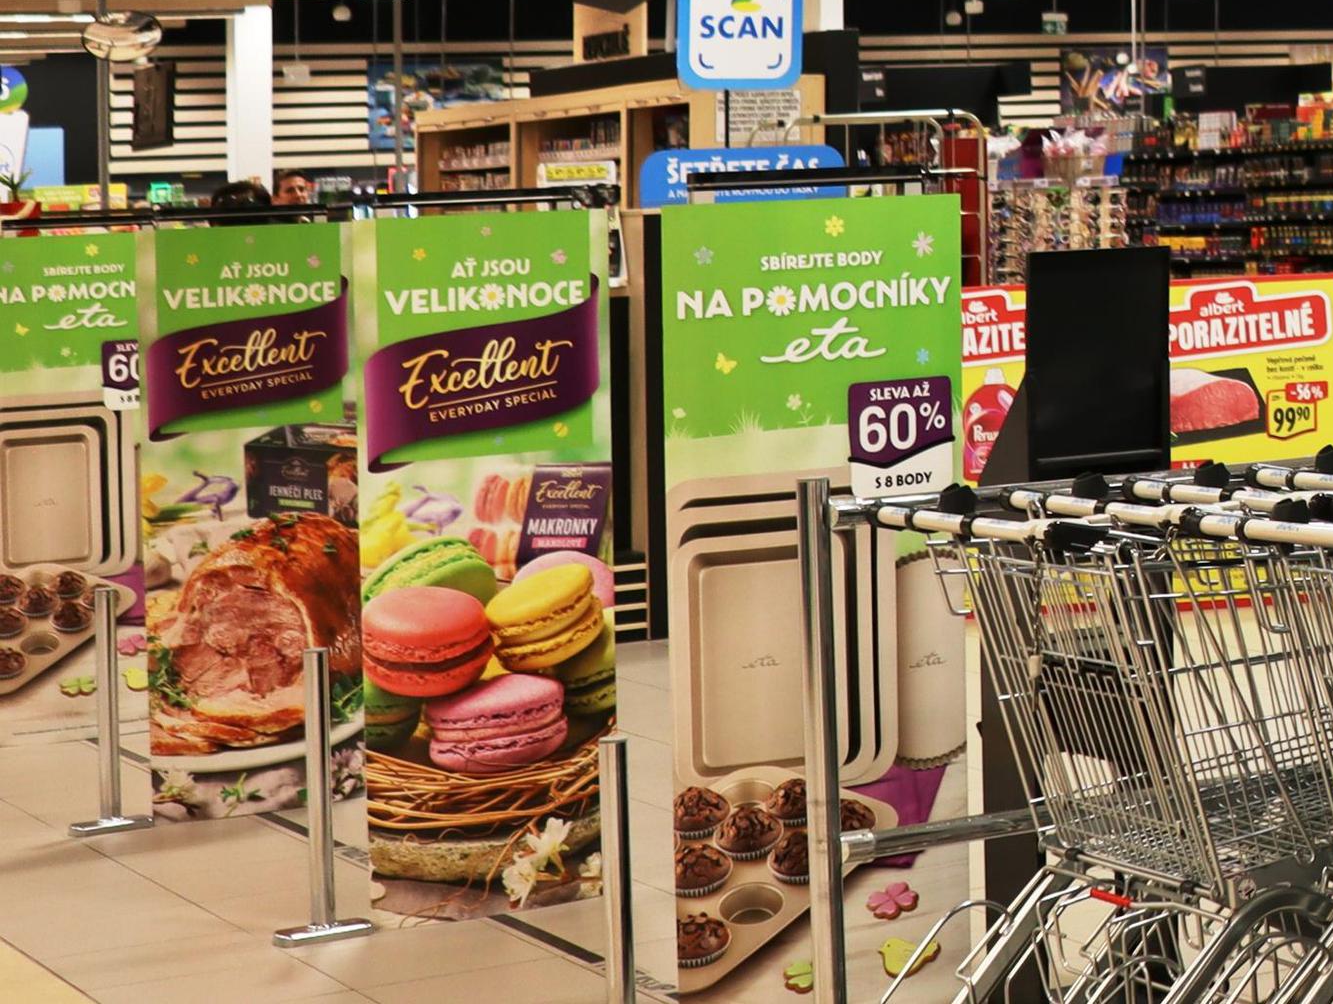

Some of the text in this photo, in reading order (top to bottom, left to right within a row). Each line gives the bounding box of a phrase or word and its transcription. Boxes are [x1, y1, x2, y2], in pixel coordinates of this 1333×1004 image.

[700, 14, 783, 39] SCAN
[94, 263, 125, 276] BODY
[220, 261, 289, 280] AŤ JSOU
[451, 257, 531, 279] AŤ JSOU
[760, 250, 883, 272] SBÍREJTE BODY
[32, 281, 135, 303] POMOCN
[163, 279, 336, 310] VELIKONOCE
[385, 279, 585, 315] VELIKONOCE
[676, 289, 734, 320] NA
[1199, 301, 1245, 318] albert
[43, 303, 127, 331] eta
[962, 309, 998, 324] lbert
[1169, 302, 1315, 352] PORAZITELNÉ
[760, 317, 887, 363] eta
[176, 328, 326, 389] Excellent
[400, 336, 573, 409] Excellent
[202, 370, 314, 400] EVERYDAY SPECIAL
[869, 382, 931, 401] SLEVA AŽ
[429, 387, 557, 423] EVERYDAY SPECIAL
[536, 479, 602, 503] Excellent
[875, 472, 932, 489] S 8 BODY
[527, 518, 598, 536] MAKRONKY
[741, 653, 781, 669] eta
[909, 651, 947, 668] eta
